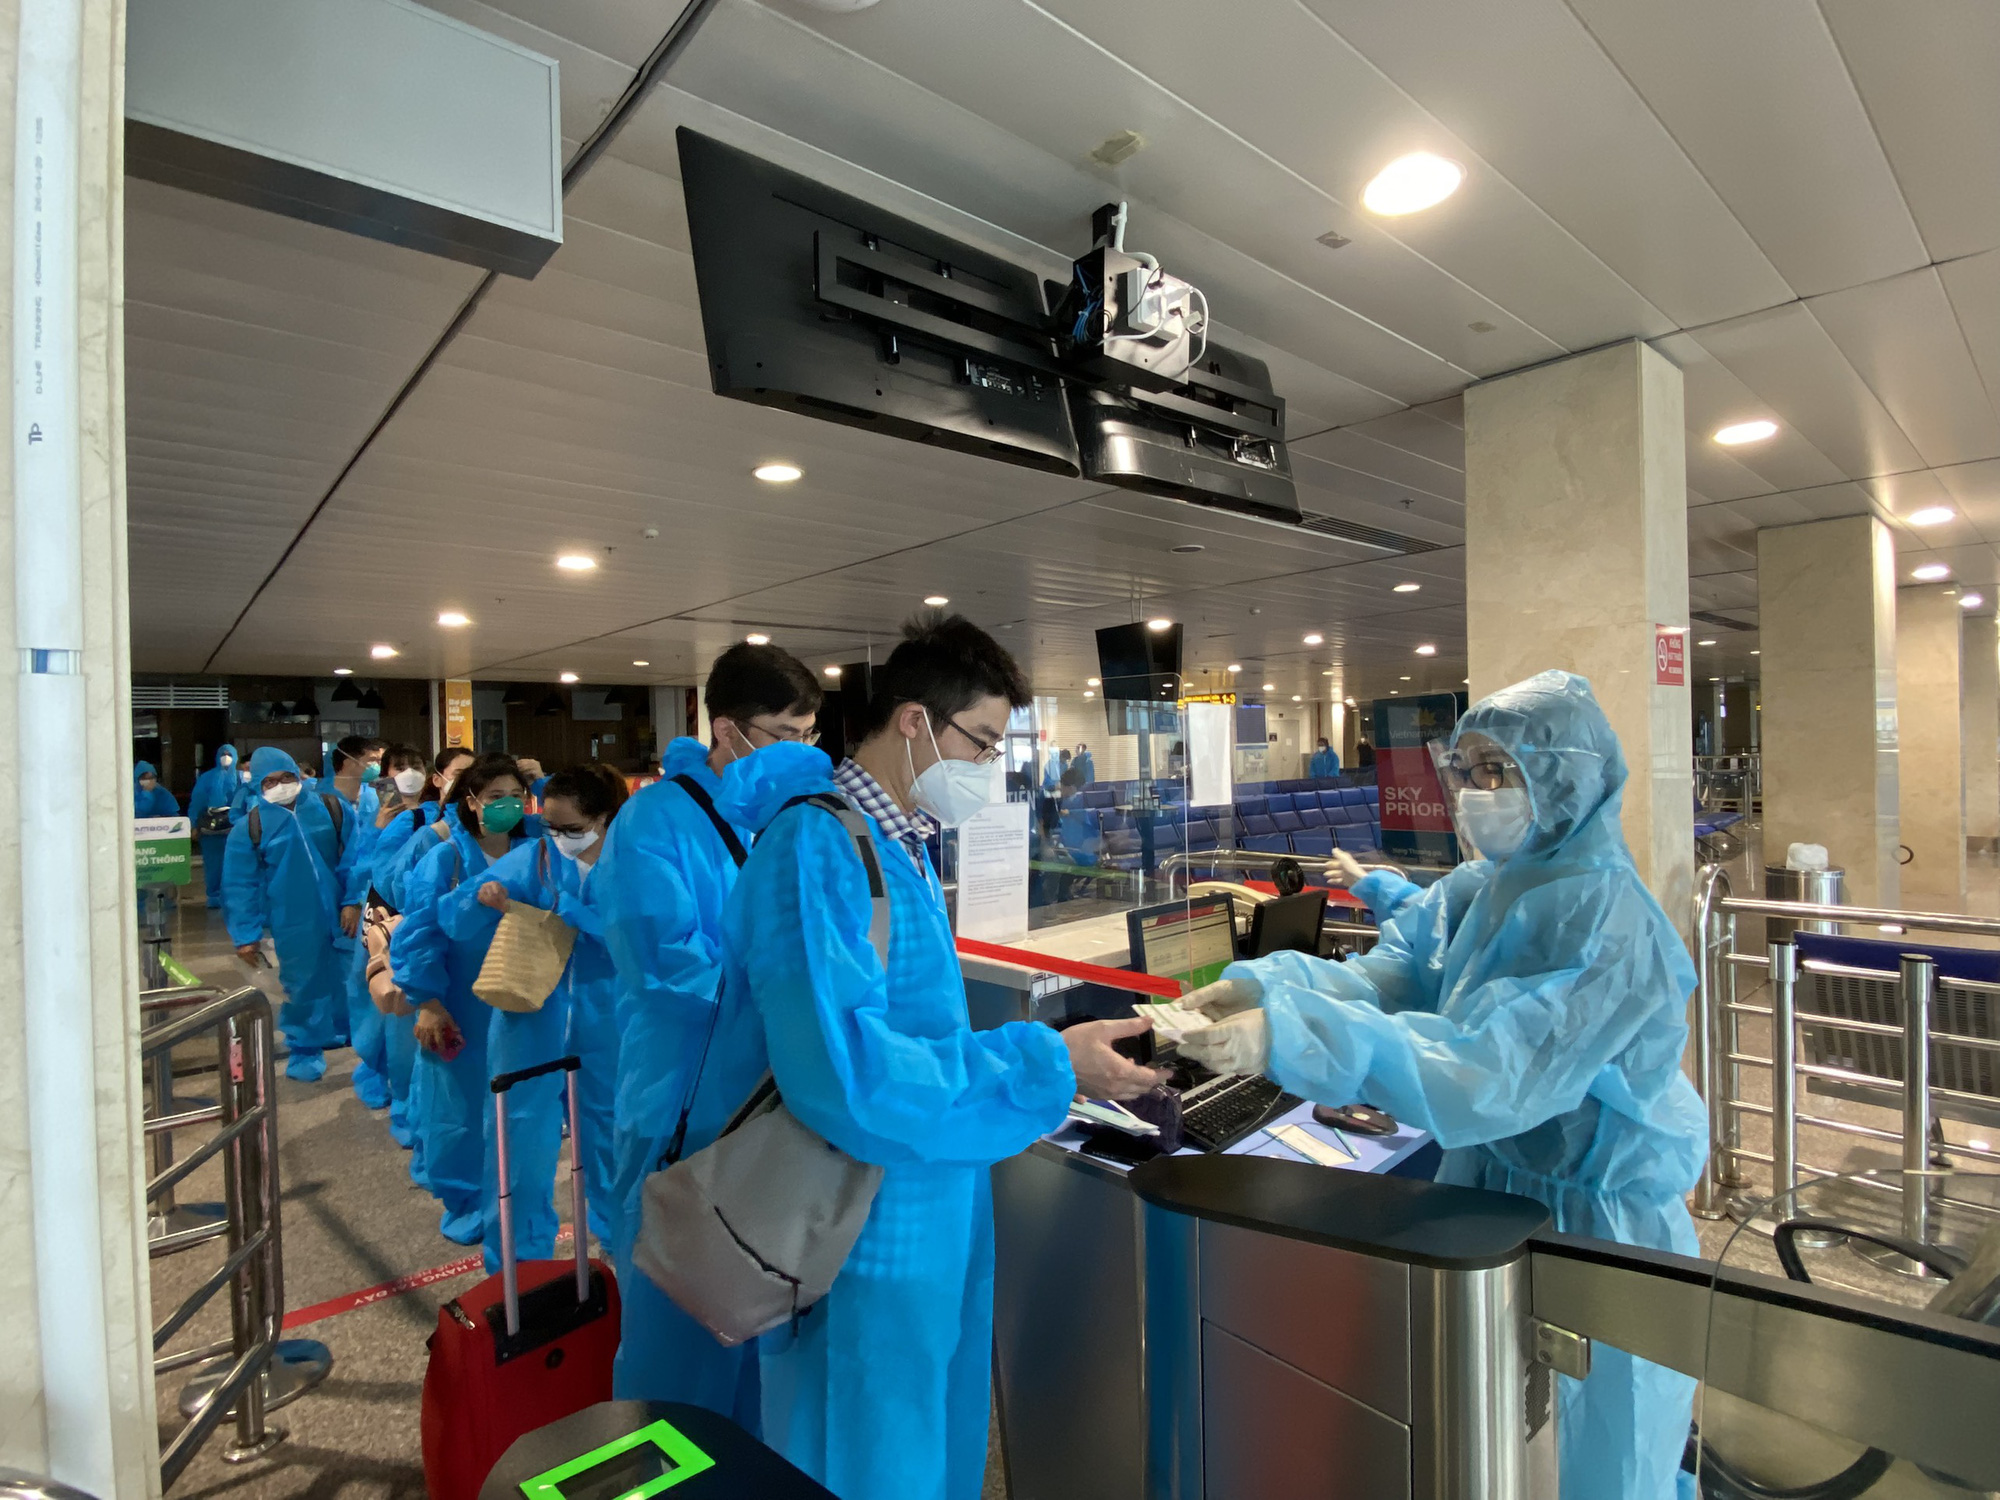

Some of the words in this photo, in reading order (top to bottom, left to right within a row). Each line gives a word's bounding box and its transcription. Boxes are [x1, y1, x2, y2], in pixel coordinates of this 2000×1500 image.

[34, 296, 42, 350] TRUNKING
[1385, 787, 1422, 800] SKY
[1385, 802, 1446, 817] PRIOR
